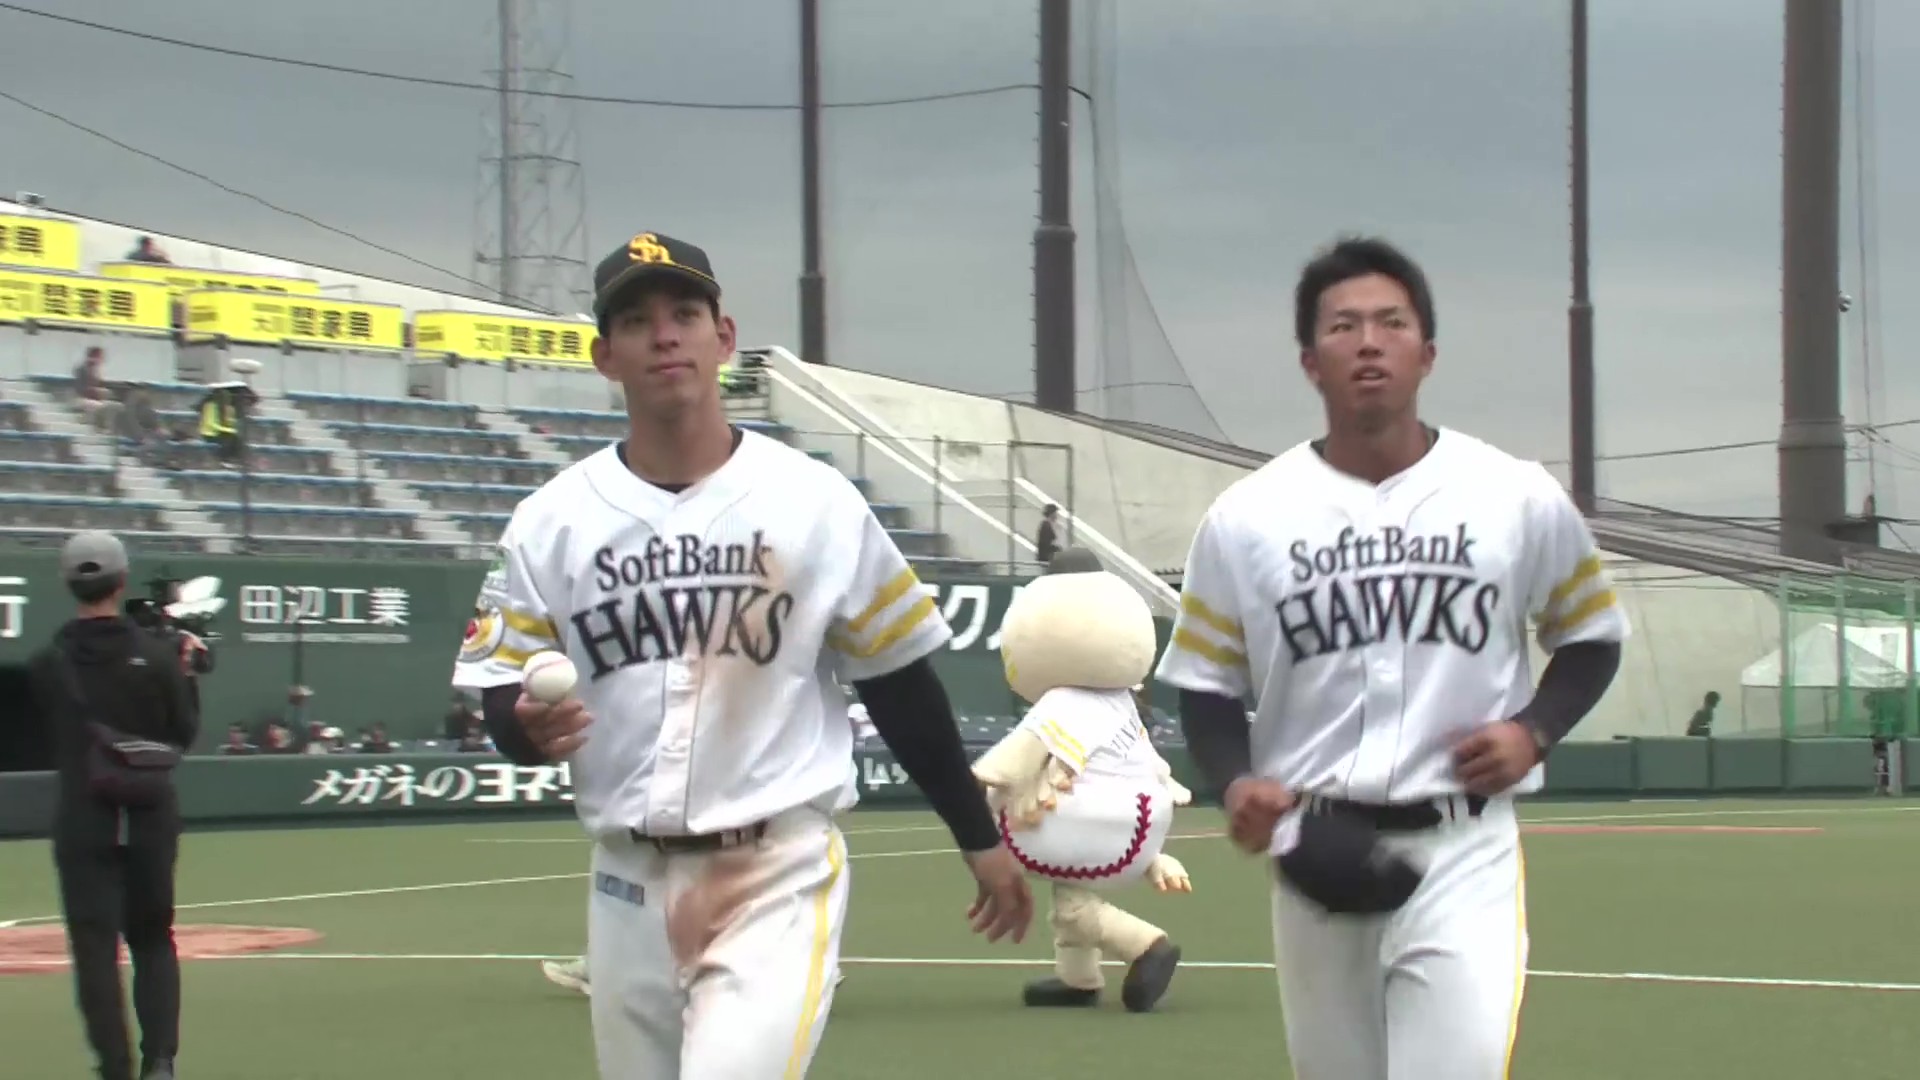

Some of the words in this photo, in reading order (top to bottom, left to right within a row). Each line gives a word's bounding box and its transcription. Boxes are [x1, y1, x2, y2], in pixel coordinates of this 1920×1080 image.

[594, 529, 773, 592] SoftBank
[239, 584, 411, 627] 田辺工業
[571, 585, 795, 681] HAWKS
[1274, 573, 1500, 665] HAWKS
